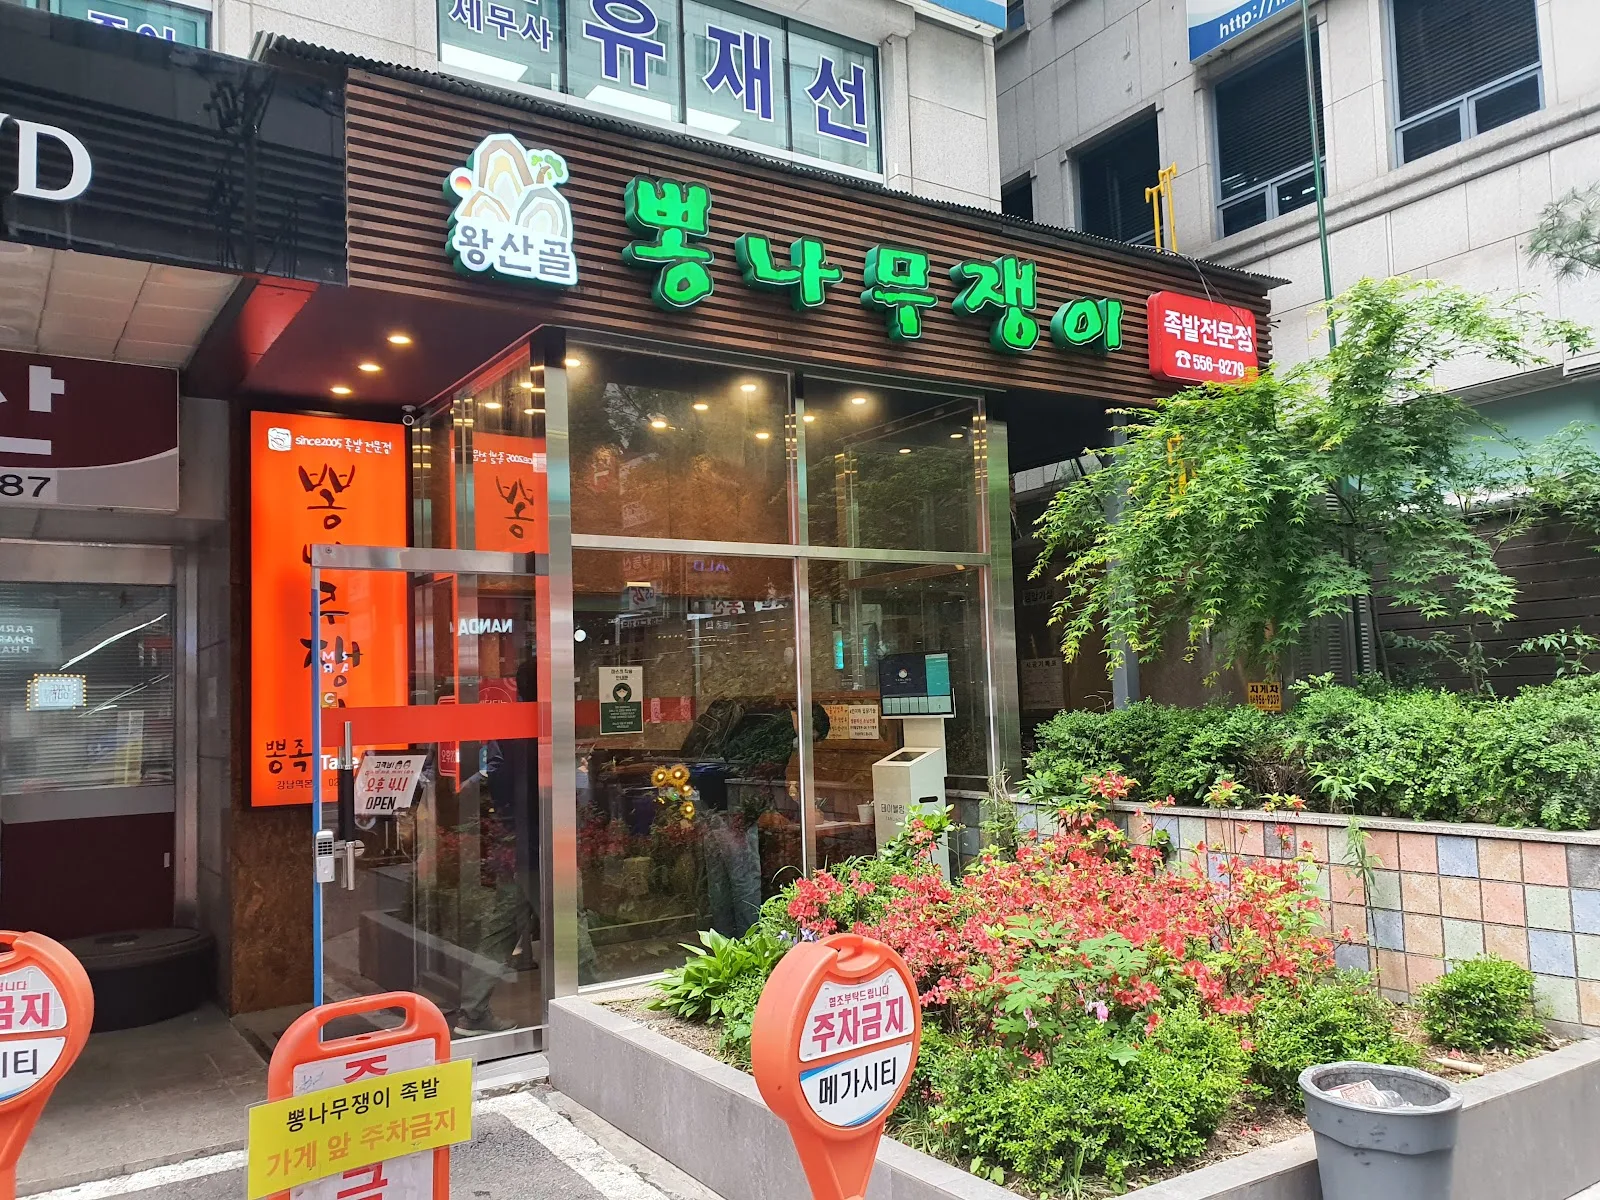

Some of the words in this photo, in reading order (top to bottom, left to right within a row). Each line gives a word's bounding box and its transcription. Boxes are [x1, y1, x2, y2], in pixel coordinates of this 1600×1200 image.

[448, 0, 553, 52] 세무사
[0, 112, 92, 200] D
[458, 223, 571, 279] 왕산골
[623, 175, 1124, 353] 뽕나무쟁이
[1163, 309, 1253, 353] 족발전문점
[1192, 353, 1245, 378] 556-9279
[294, 435, 342, 448] since2005
[344, 437, 363, 454] 족발
[364, 441, 392, 454] 전문점
[320, 754, 360, 771] Tae
[365, 777, 385, 792] 오후
[388, 777, 409, 792] 4시
[365, 796, 397, 810] OPEN
[828, 985, 890, 1008] 협조부탁드립니다
[812, 996, 904, 1053] 주차금지
[286, 1087, 391, 1133] 뽕나무쟁이
[400, 1077, 440, 1103] 족발
[819, 1057, 897, 1105] 메가시티
[266, 1140, 317, 1178] 가게
[327, 1132, 352, 1163] 앞
[359, 1106, 456, 1151] 주차금지
